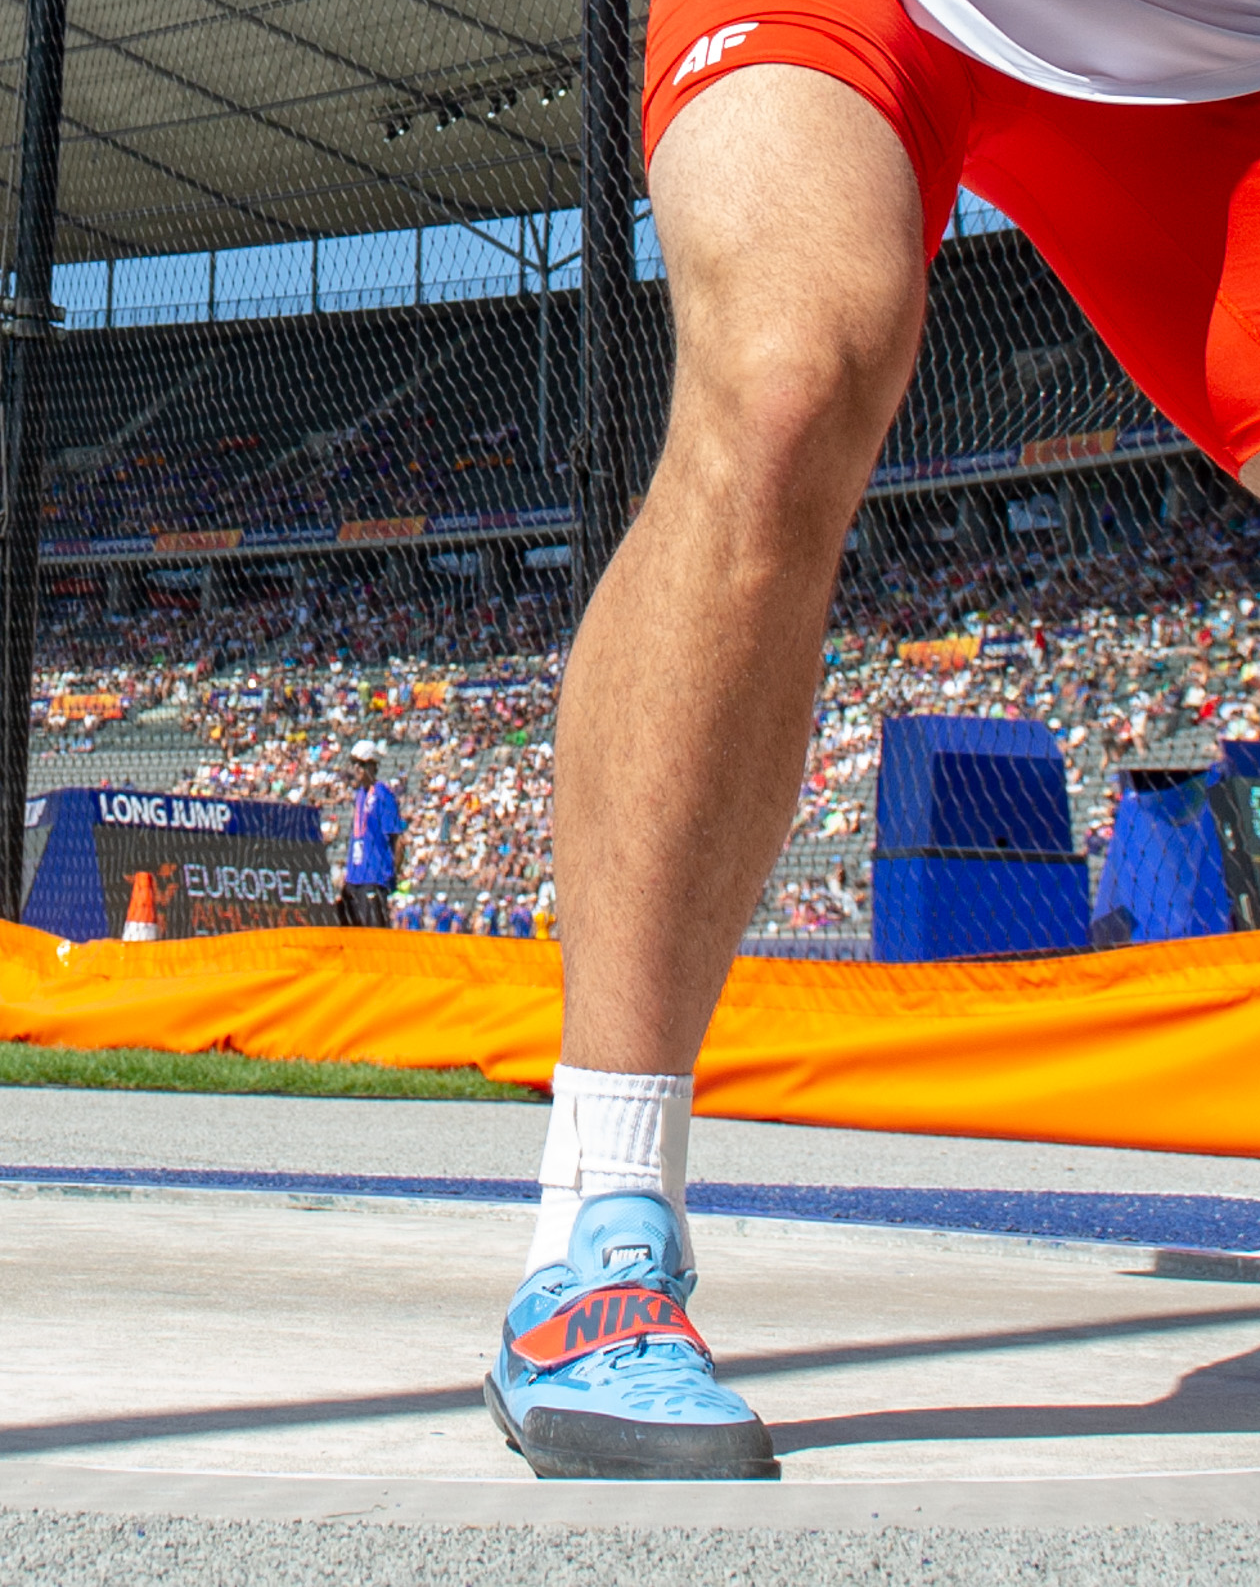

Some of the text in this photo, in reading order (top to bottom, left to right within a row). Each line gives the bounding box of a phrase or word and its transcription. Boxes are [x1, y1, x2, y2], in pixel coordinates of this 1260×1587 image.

[100, 793, 232, 833] LONG JUMP
[183, 863, 336, 906] EUROPEAN
[565, 1294, 685, 1351] NIKE
